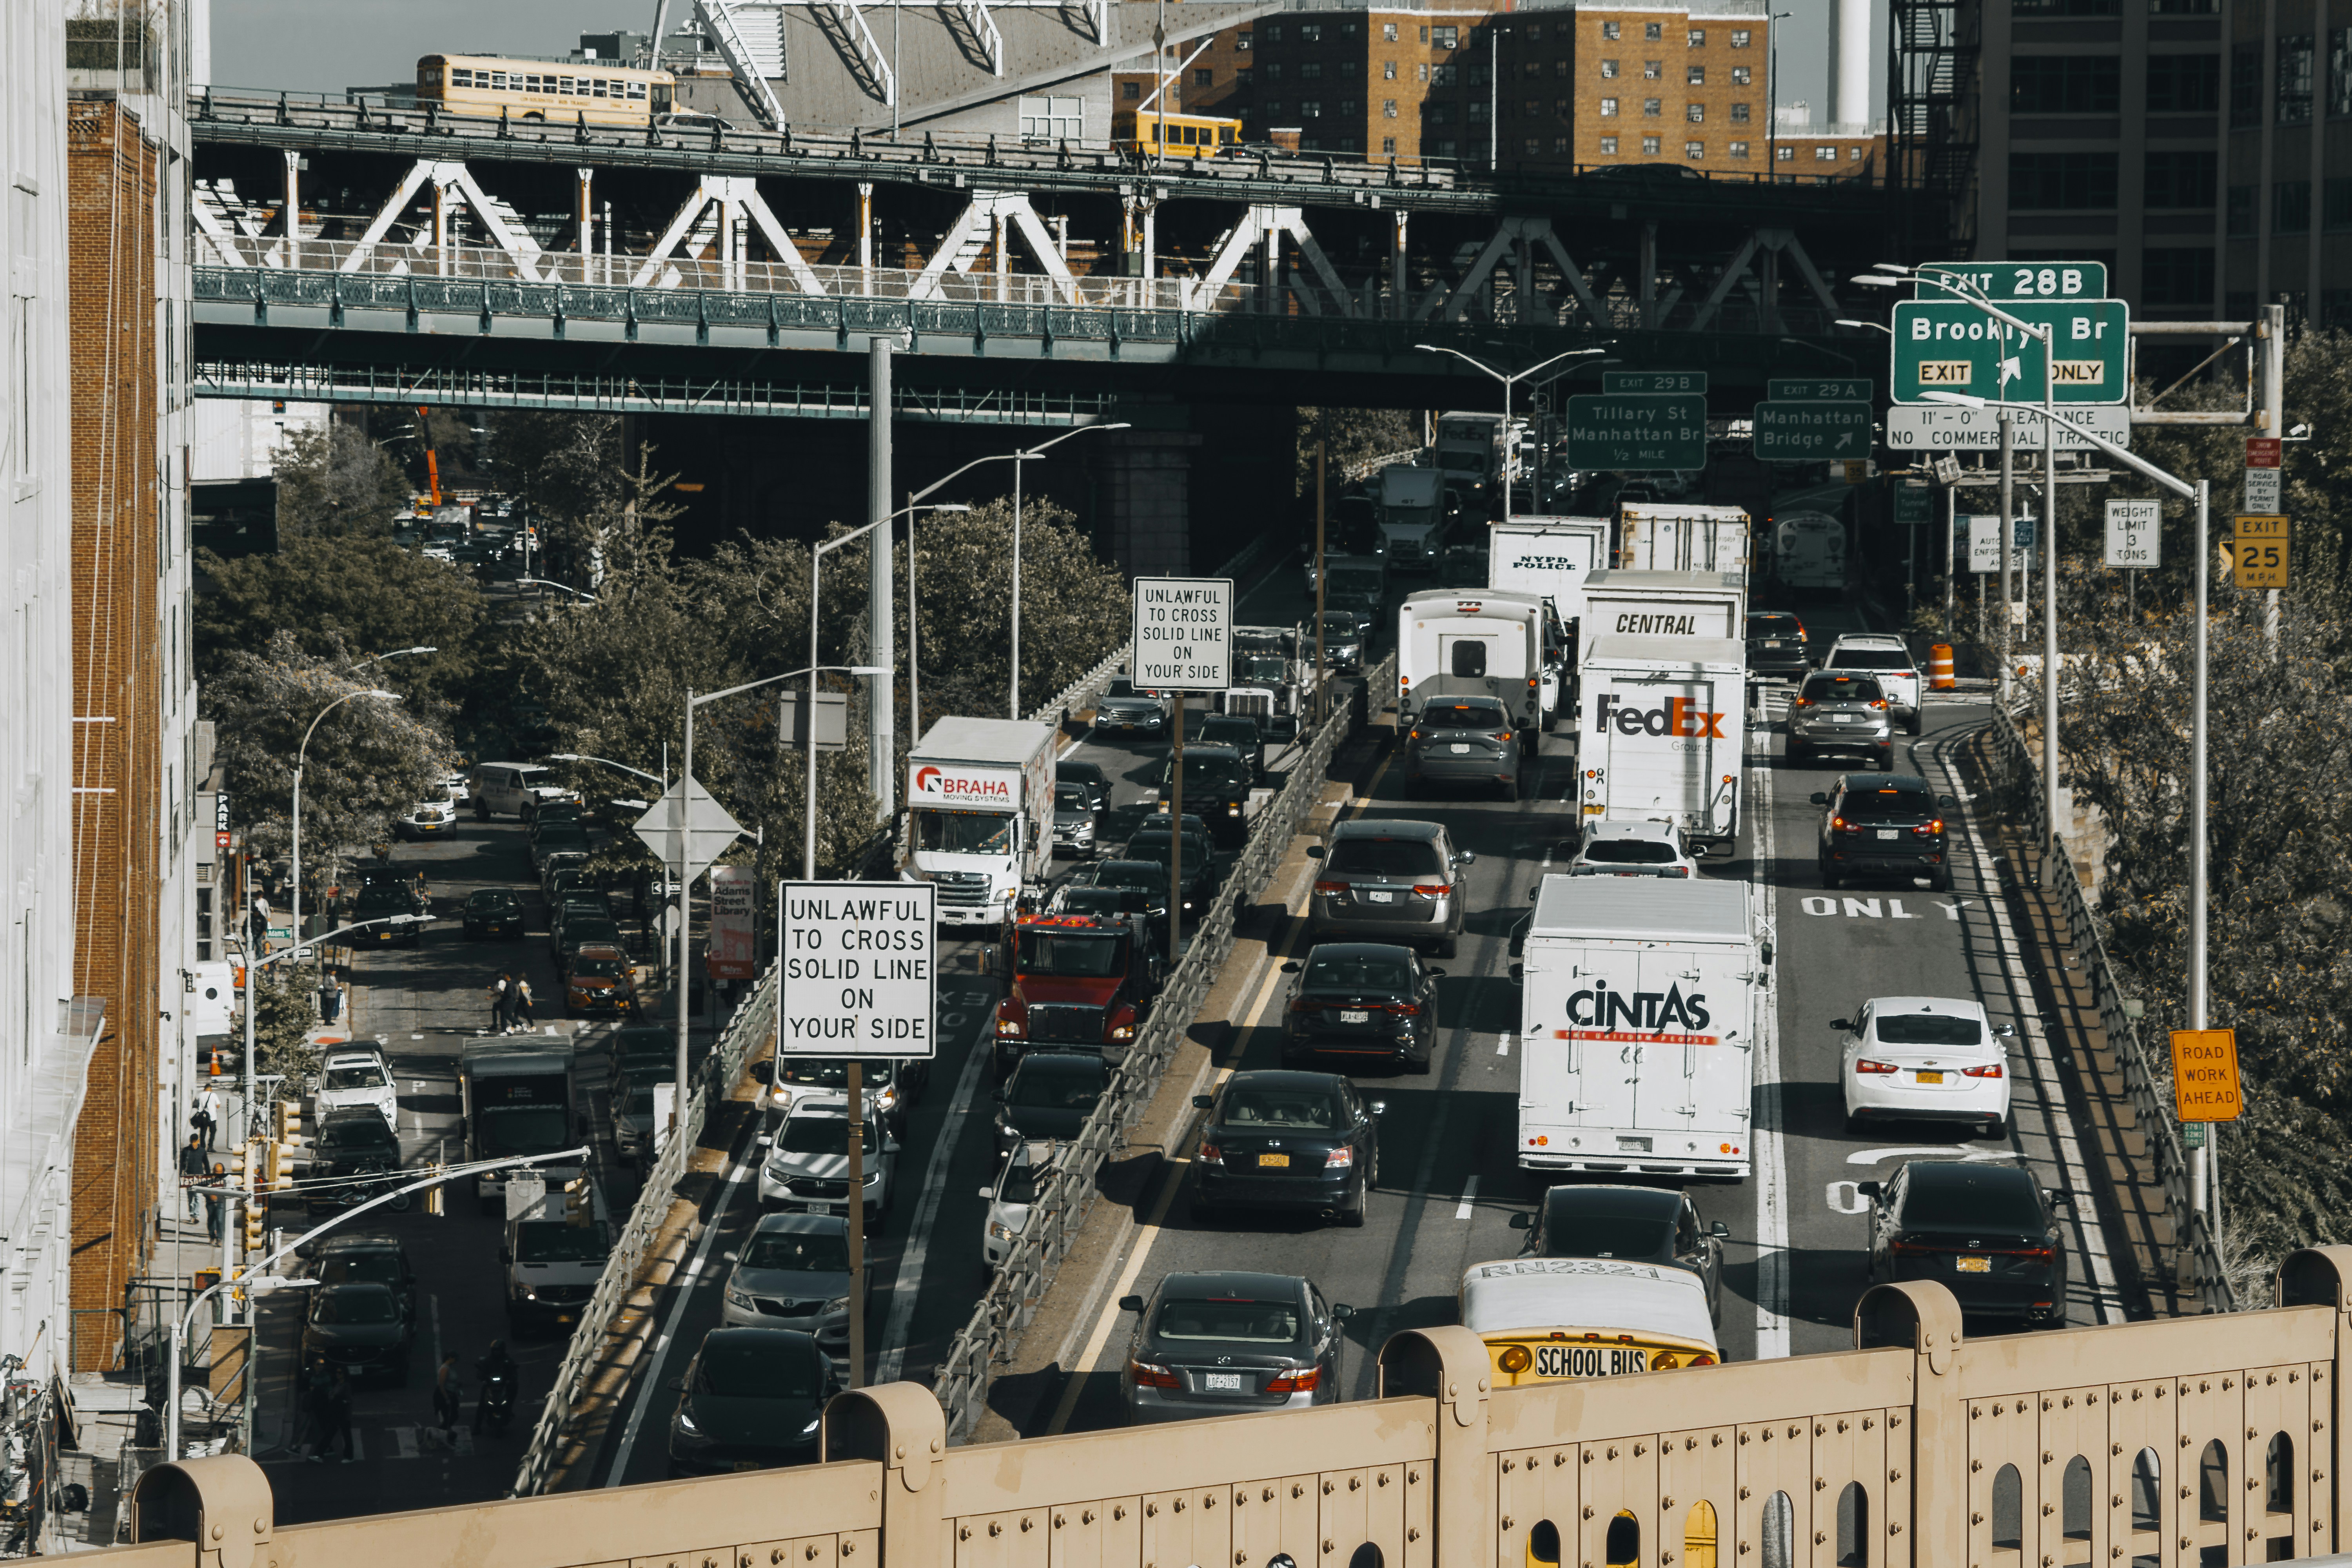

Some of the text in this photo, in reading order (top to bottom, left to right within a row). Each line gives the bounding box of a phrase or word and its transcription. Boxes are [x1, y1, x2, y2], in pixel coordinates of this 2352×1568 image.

[1940, 269, 2083, 295] EXIT 28B
[2071, 317, 2108, 340] Br
[1921, 365, 1968, 381] EXIT
[1619, 379, 1644, 387] EXIT
[1654, 377, 1675, 389] 29
[1784, 386, 1808, 395] EXIT
[1818, 384, 1839, 397] 29
[1592, 407, 1687, 423] Tillary St
[1763, 410, 1864, 424] Manhattan
[1442, 426, 1486, 441] FedEx
[1573, 427, 1700, 441] Manhattan Br
[1764, 431, 1824, 449] Bridge
[1891, 431, 1913, 444] NO
[1932, 431, 2038, 445] COMMERIAL
[1639, 450, 1665, 459] MILE
[1901, 499, 1927, 507] Tunnel
[2111, 507, 2154, 517] WEIGHT
[2118, 521, 2147, 530] LIMIT
[2243, 521, 2279, 533] EXIT
[2127, 535, 2136, 546] 3
[2117, 550, 2147, 560] TONS
[2242, 546, 2279, 568] 25
[1146, 589, 1220, 604] UNLAWFUL
[1149, 608, 1217, 622] TO CROSS
[1616, 614, 1695, 635] CENTRAL
[1143, 627, 1221, 641] SOLID LINE
[1174, 646, 1192, 659] ON
[1145, 664, 1219, 679] YOUR SIDE
[1596, 693, 1727, 739] FedEx
[944, 778, 1009, 796] BRAHA
[218, 795, 229, 830] PARK
[714, 887, 750, 895] Adams
[714, 896, 746, 905] Street
[714, 906, 750, 916] Library
[791, 899, 925, 921] UNLAWFUL
[1800, 896, 1973, 920] ONLY
[793, 929, 924, 951] TO CROSS
[788, 958, 927, 980] SOLID LINE
[842, 988, 873, 1009] ON
[789, 1018, 855, 1038] YOUR
[871, 1018, 925, 1039] SIDE
[1661, 1034, 1708, 1044] PEOPLE
[2183, 1047, 2223, 1059] ROAD
[2185, 1069, 2228, 1082] WORK
[2183, 1091, 2234, 1105] AHEAD
[1481, 1261, 1660, 1279] RN2321
[1538, 1348, 1644, 1377] SCHOOL BUS
